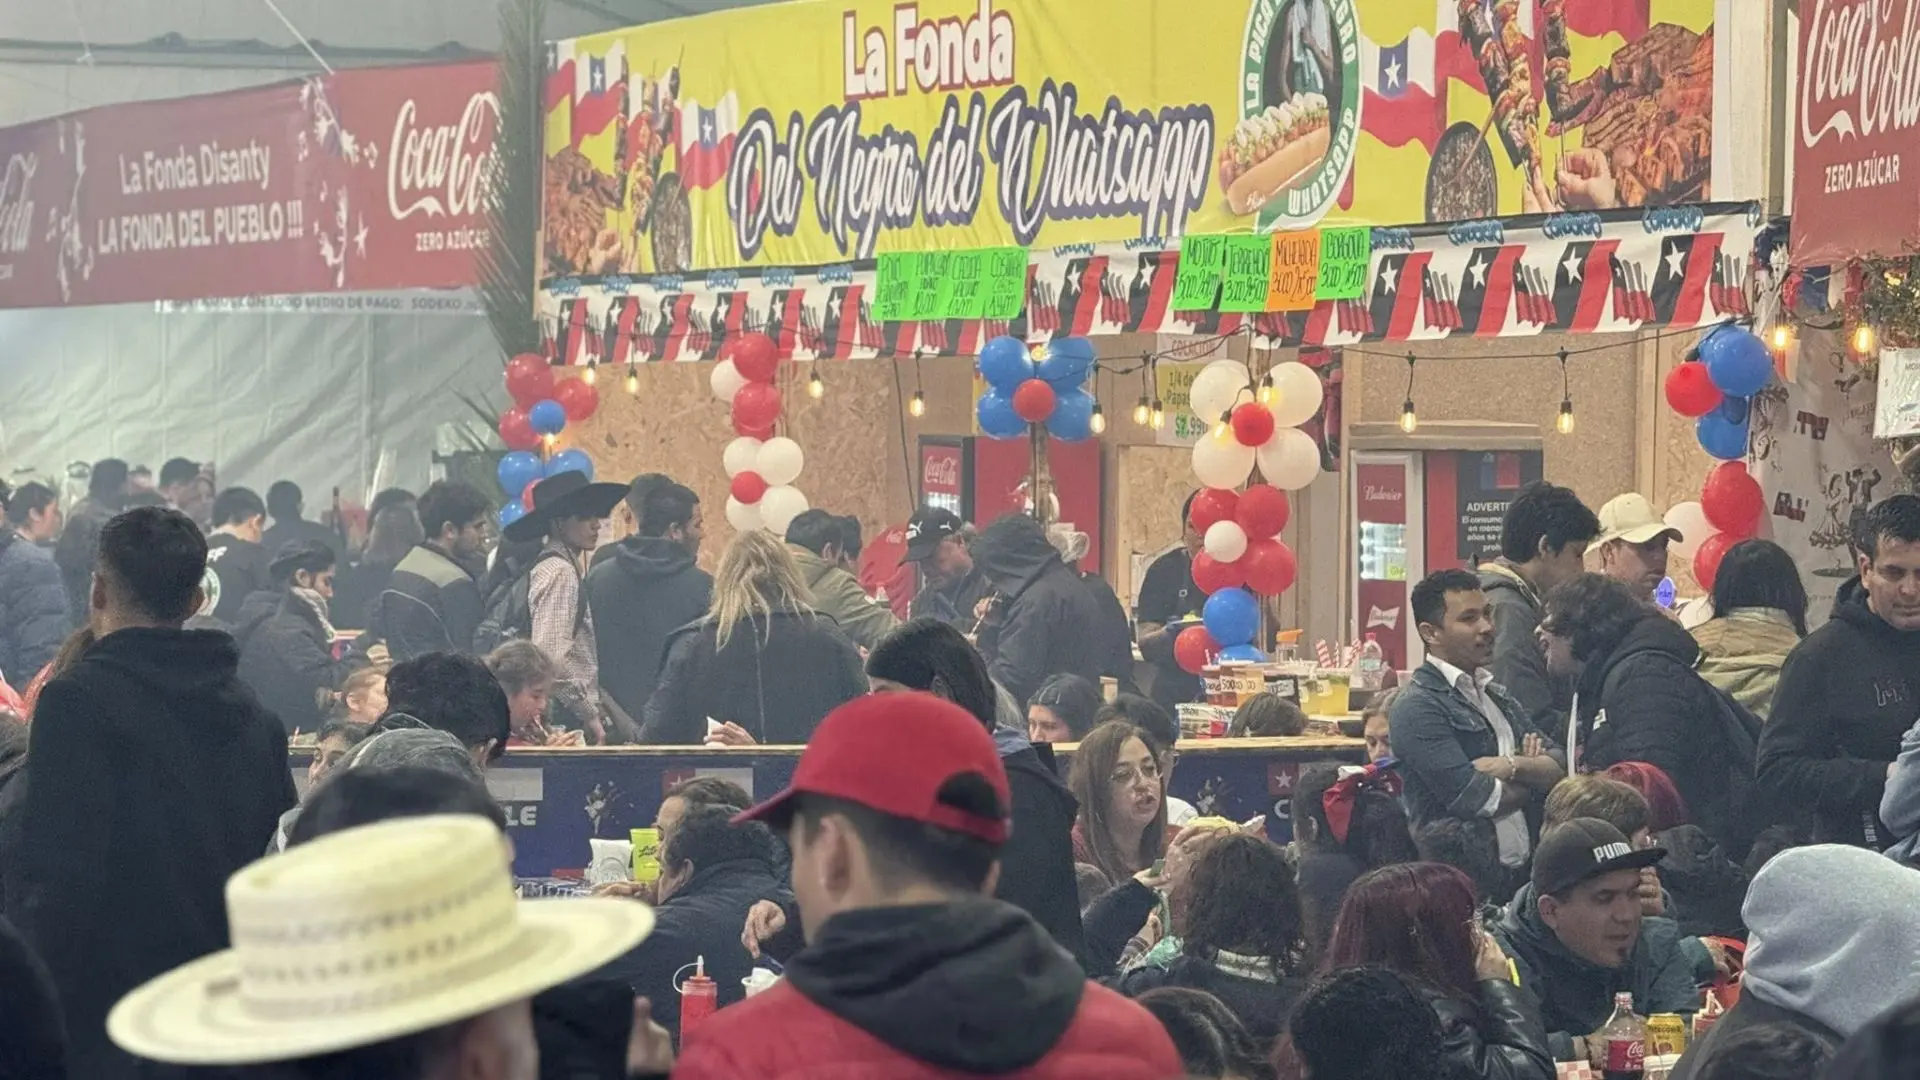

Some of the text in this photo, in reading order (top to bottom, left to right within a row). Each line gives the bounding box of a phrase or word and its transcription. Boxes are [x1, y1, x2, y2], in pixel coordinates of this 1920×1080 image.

[843, 0, 1016, 101] La Fonda
[1246, 72, 1260, 109] LA
[121, 141, 270, 195] La Fonda Disanty
[727, 76, 1216, 260] Del Negro del Whatsapp
[1288, 107, 1354, 215] WHATSAPP
[1825, 151, 1900, 193] ZERO AZÚCAR
[99, 200, 303, 253] LA FONDA DEL PUEBLO !!!
[416, 231, 443, 251] ZERO
[924, 456, 957, 486] Coca-Cola
[1593, 842, 1632, 863] PUMA
